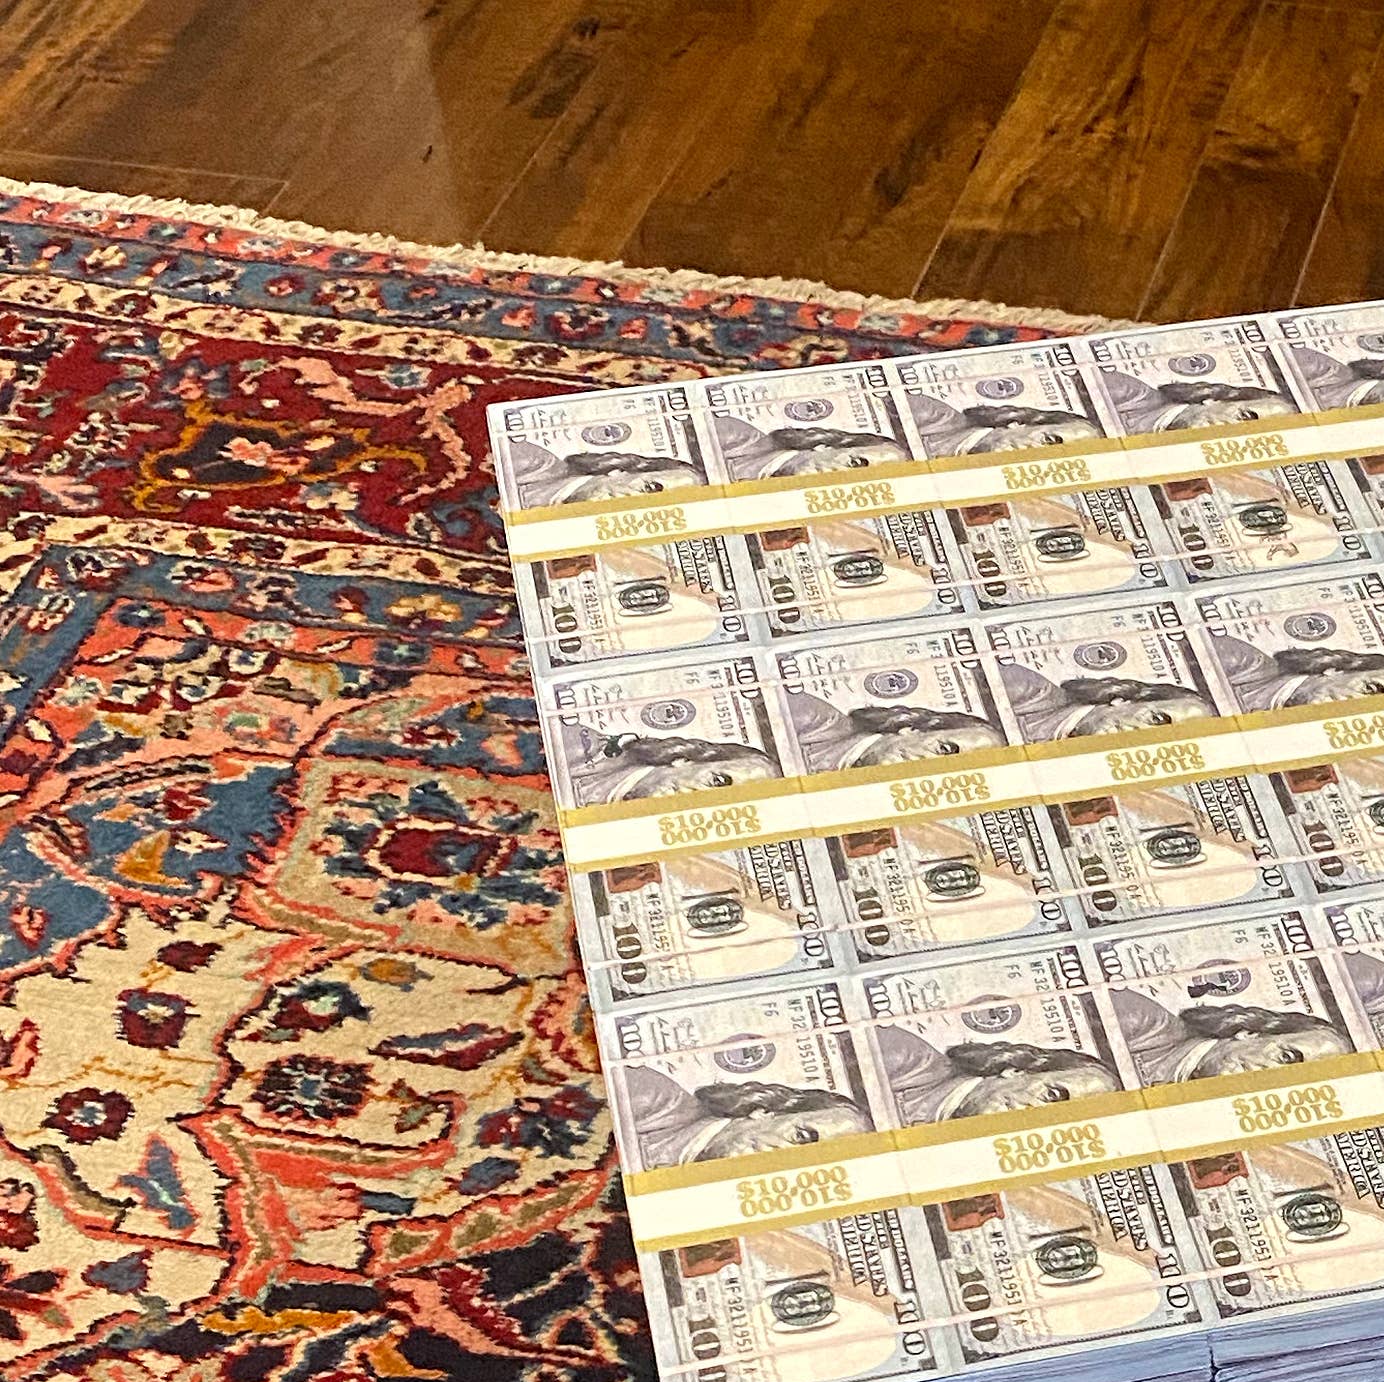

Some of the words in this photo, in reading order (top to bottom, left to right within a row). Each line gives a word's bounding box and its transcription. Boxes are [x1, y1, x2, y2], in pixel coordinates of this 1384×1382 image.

[1198, 434, 1286, 456] $10,000
[1202, 442, 1290, 465] $10,000
[1000, 458, 1089, 481] $10,000
[1003, 466, 1093, 490] $10,000
[803, 481, 893, 505] $10,000
[806, 490, 896, 514] $10,000
[594, 507, 686, 531] $10,000
[596, 516, 688, 540] $10,000
[1105, 741, 1203, 769] $10,000
[1109, 753, 1207, 781] $10,000
[888, 771, 988, 800] $10,000
[892, 783, 992, 812] $10,000
[657, 804, 758, 833] $10,000
[660, 815, 761, 845] $10,000
[1230, 929, 1249, 944] F6
[1004, 964, 1023, 980] F6
[761, 1002, 779, 1018] F6
[1230, 1084, 1340, 1119] $10,000
[1235, 1097, 1345, 1133] $10,000
[992, 1123, 1103, 1159] $10,000
[996, 1137, 1108, 1173] $10,000
[735, 1165, 849, 1202] $10,000
[738, 1179, 853, 1217] $10,000
